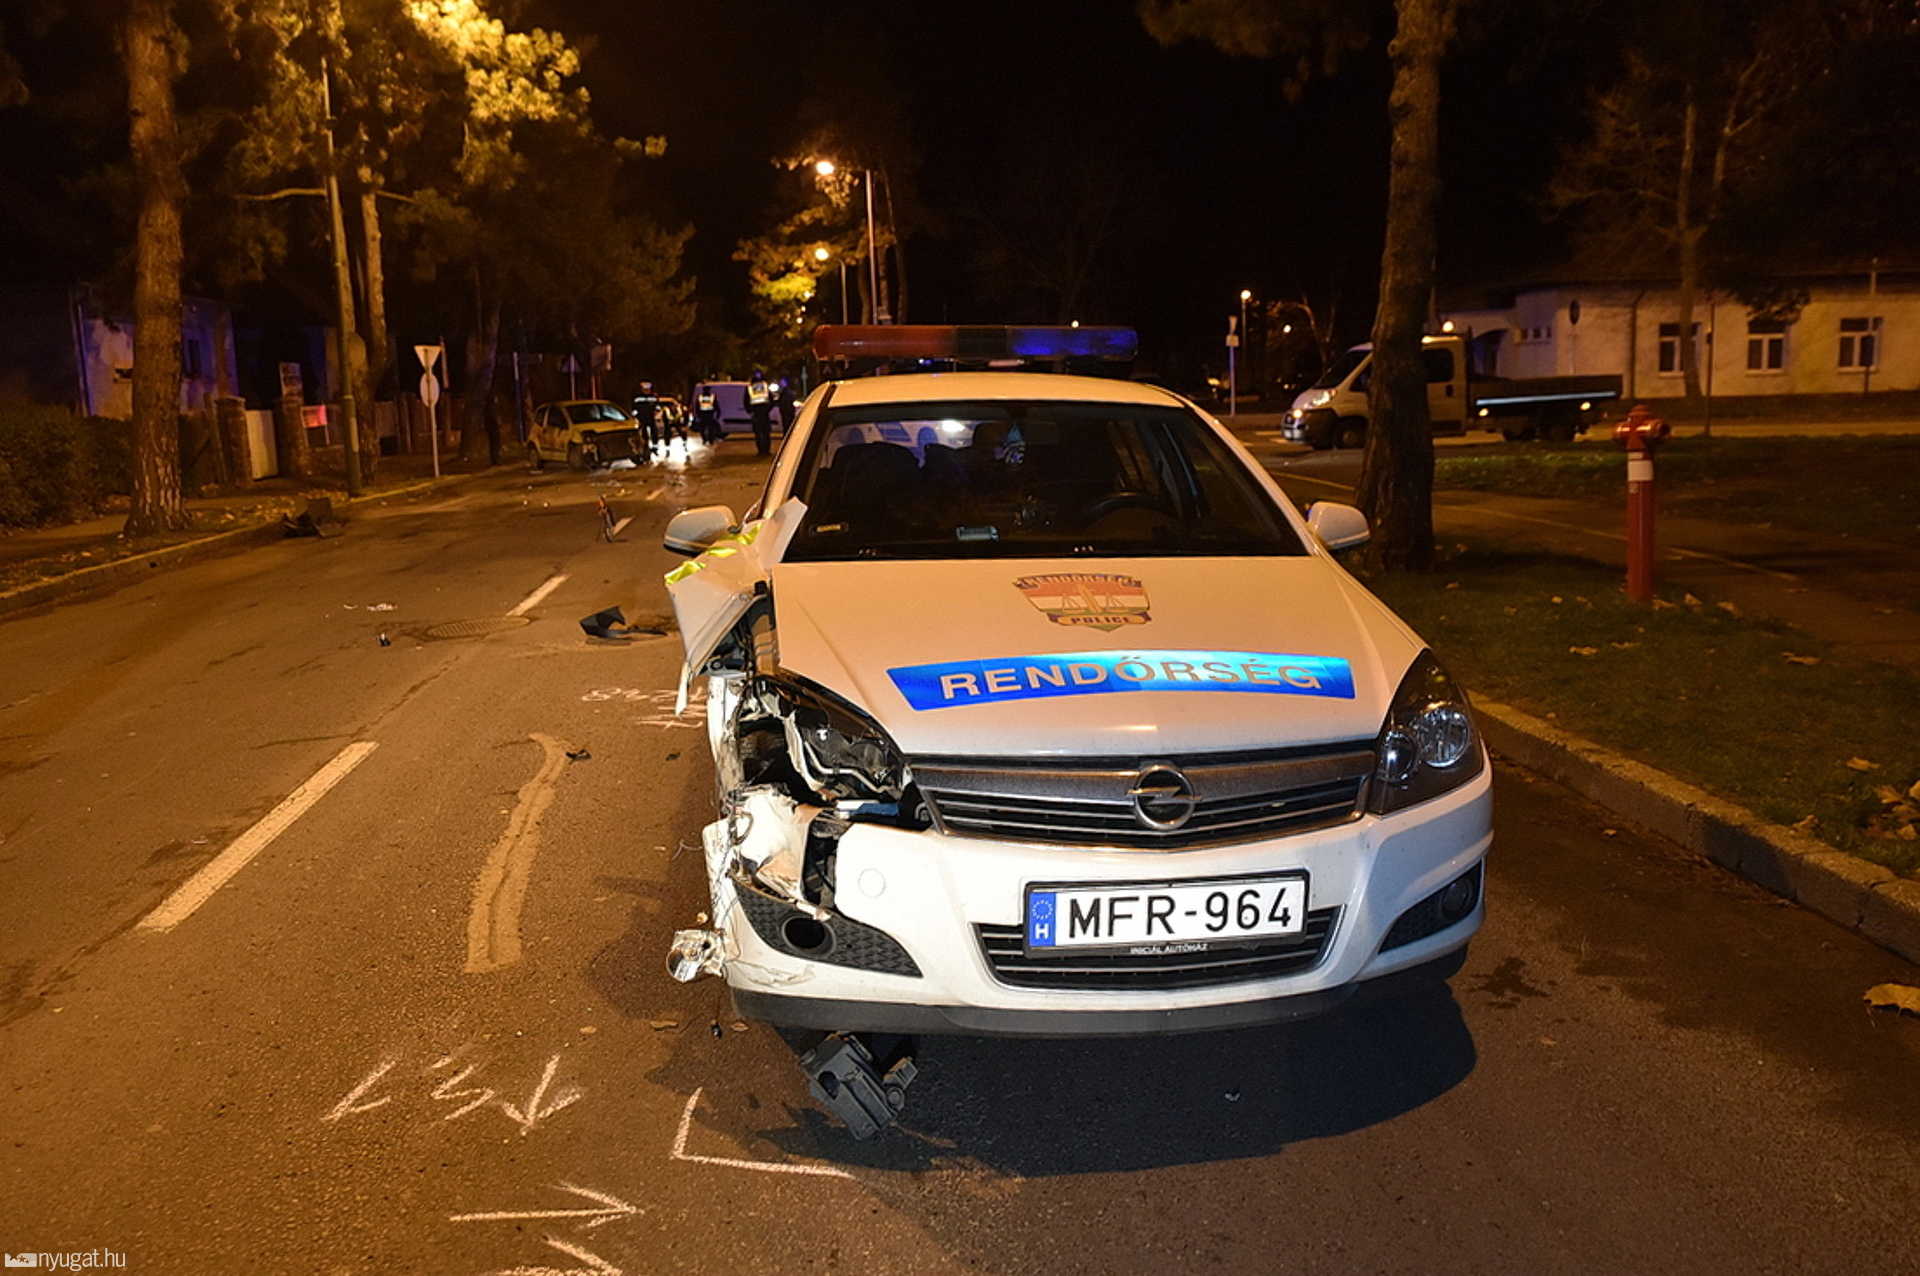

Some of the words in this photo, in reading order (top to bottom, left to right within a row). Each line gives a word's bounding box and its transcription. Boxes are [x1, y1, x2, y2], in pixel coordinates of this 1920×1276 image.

[1070, 614, 1130, 625] POLICE
[940, 655, 1322, 698] RENDŐRSÉG
[1068, 887, 1291, 938] MFR-964
[1035, 923, 1050, 939] H
